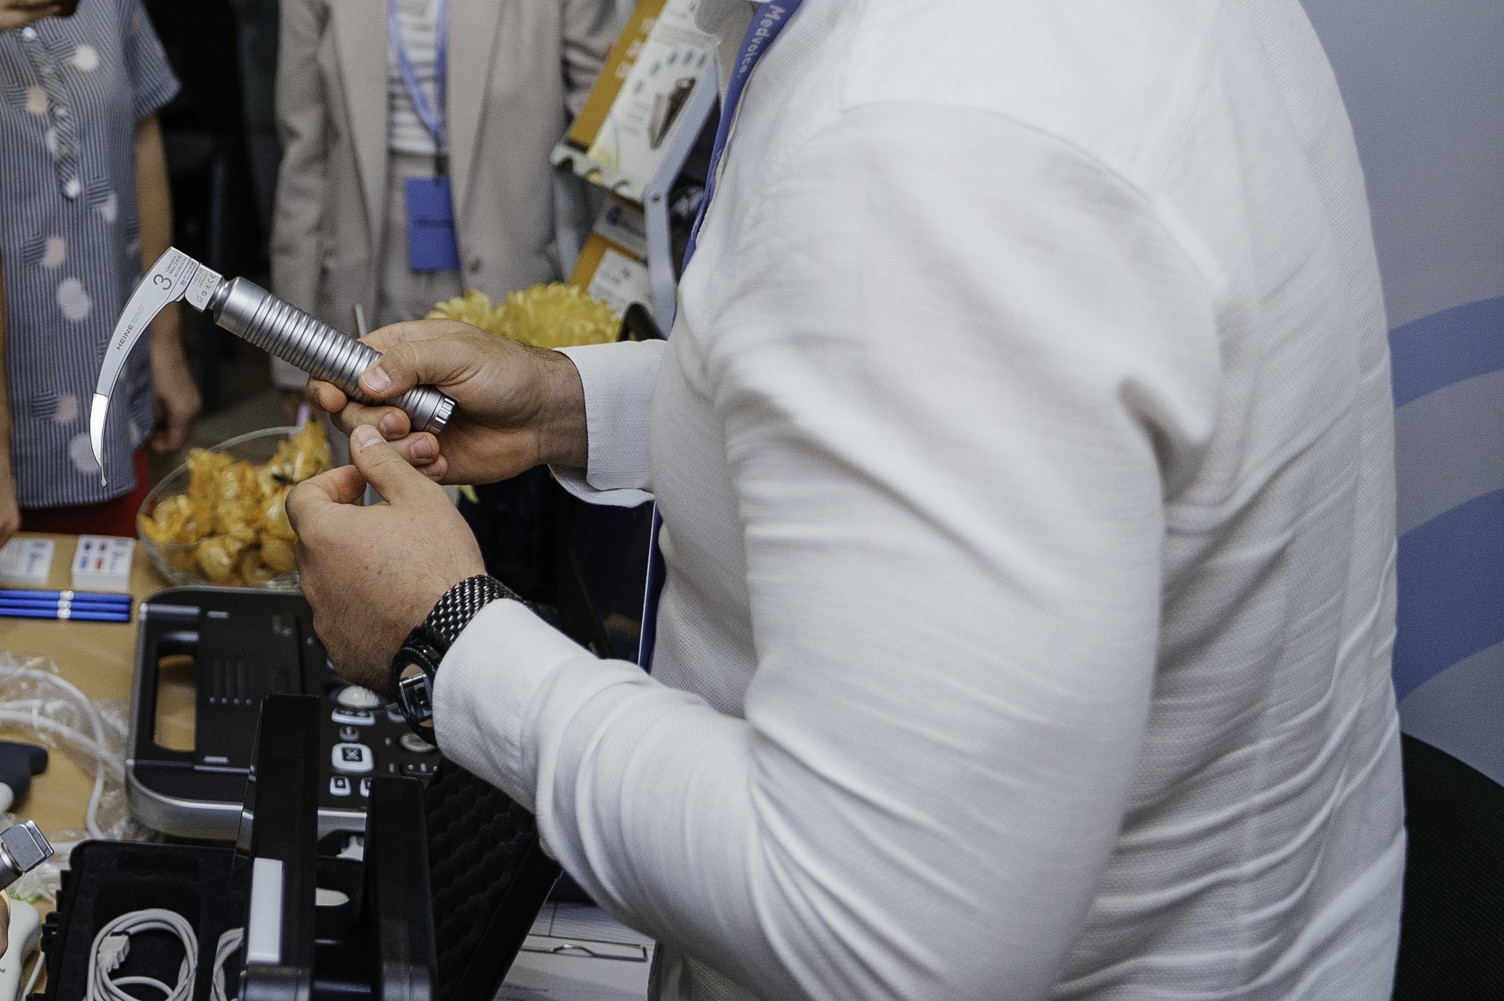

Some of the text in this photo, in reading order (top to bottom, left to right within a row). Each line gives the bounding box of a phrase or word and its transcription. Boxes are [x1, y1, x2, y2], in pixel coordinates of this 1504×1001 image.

[736, 3, 786, 79] Medvoice.
[153, 274, 172, 291] 3
[116, 324, 134, 351] HEINE
